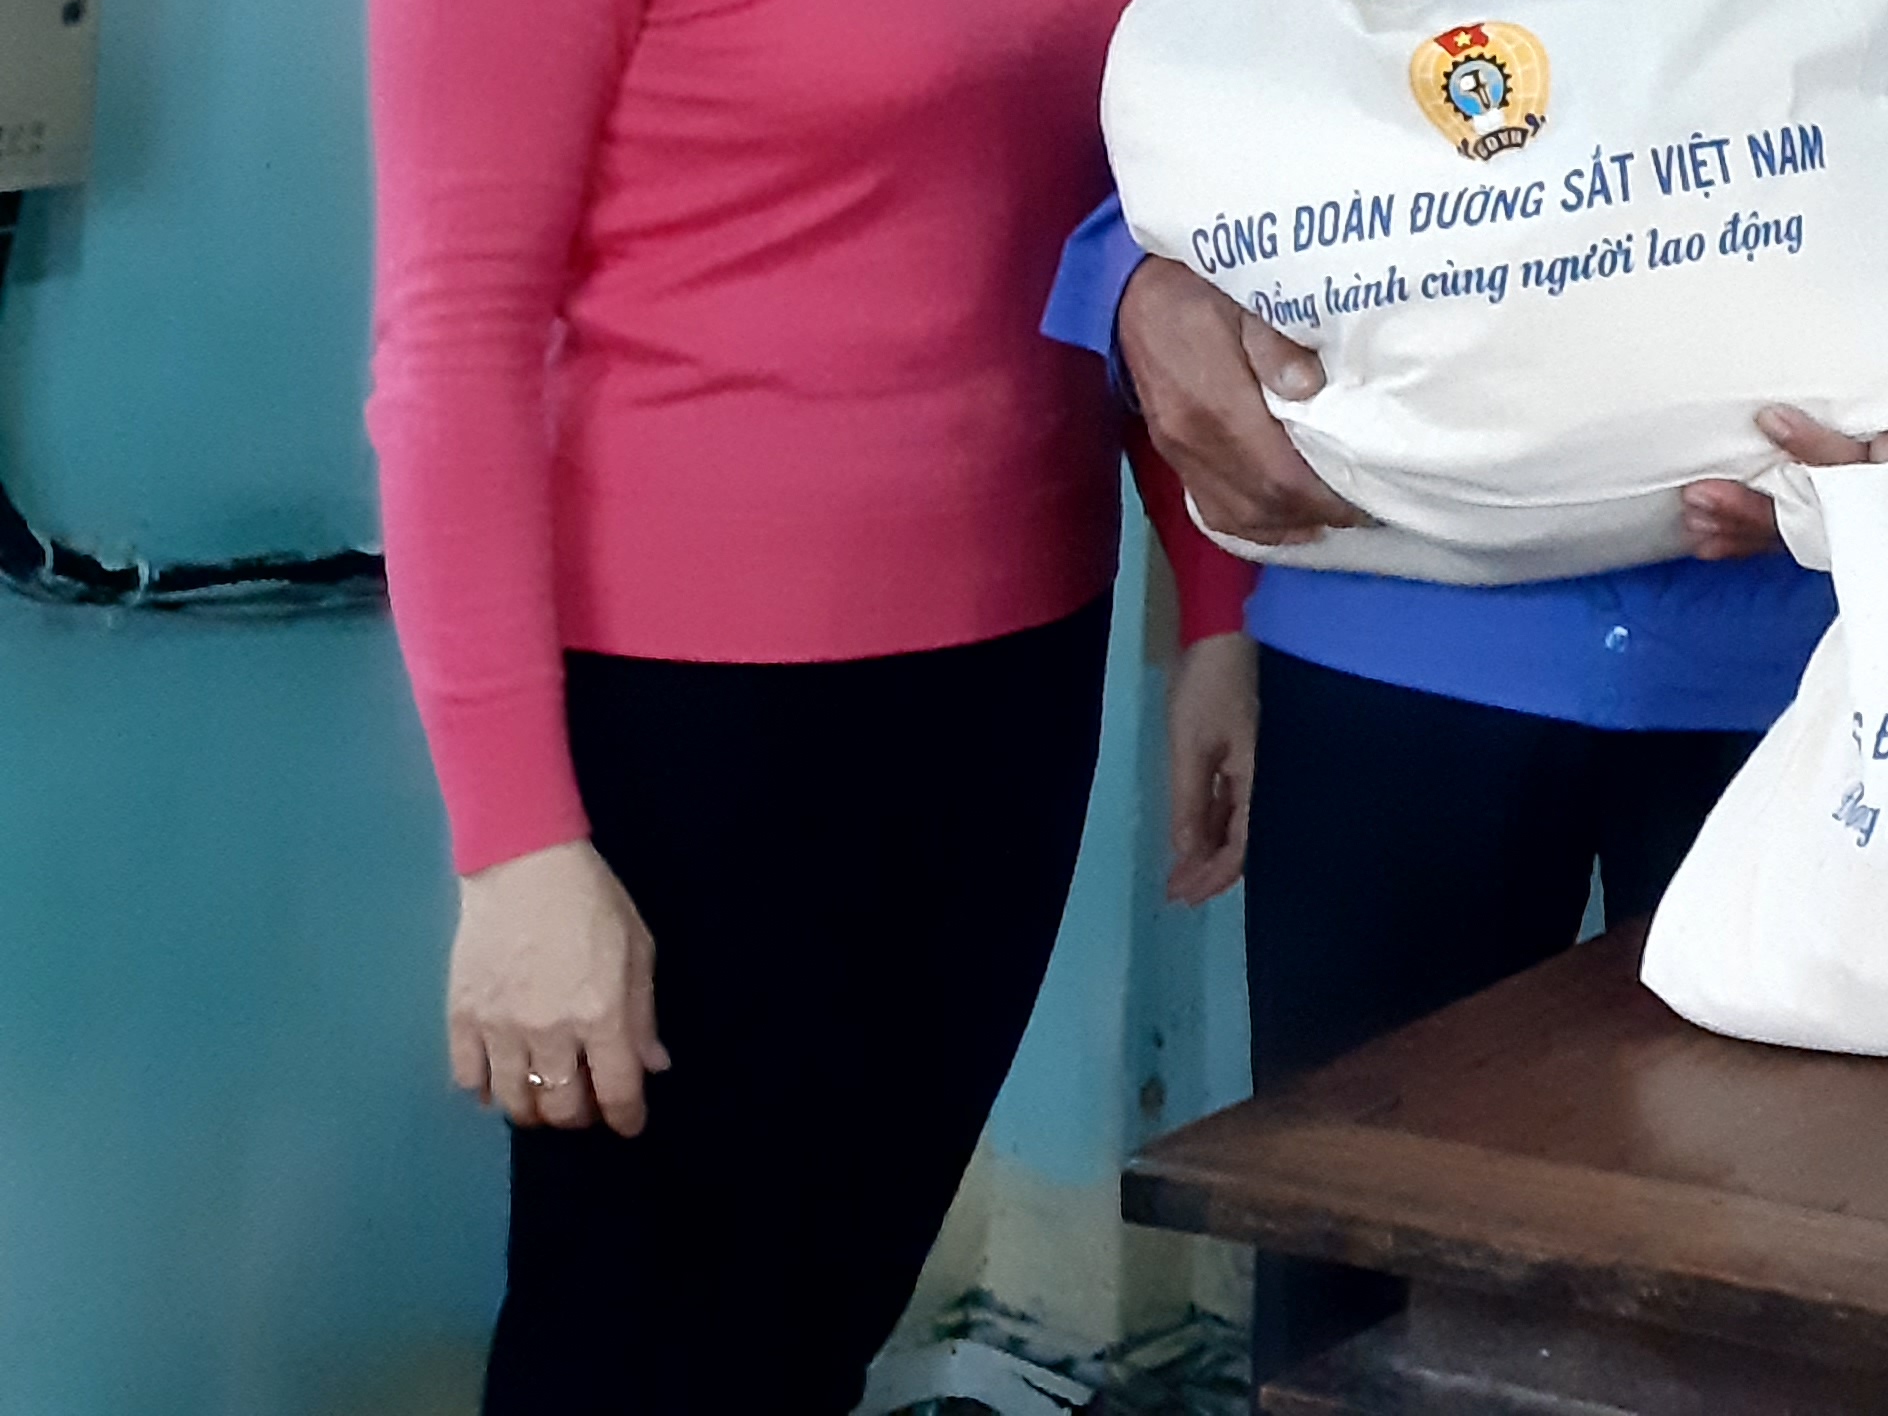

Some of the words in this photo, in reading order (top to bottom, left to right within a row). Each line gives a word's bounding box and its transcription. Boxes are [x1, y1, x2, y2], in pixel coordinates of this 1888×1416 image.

[1192, 212, 1278, 274] CÔNG
[1293, 190, 1394, 252] ĐOÀN
[1410, 179, 1545, 234] ĐƯỜNG
[1560, 146, 1635, 213] SẮT
[1652, 133, 1732, 197] VIỆT
[1748, 123, 1828, 176] NAM
[1325, 259, 1411, 317] hành
[1419, 254, 1508, 304] cùng
[1519, 235, 1635, 298] người
[1647, 227, 1705, 269] lao
[1716, 210, 1805, 256] động
